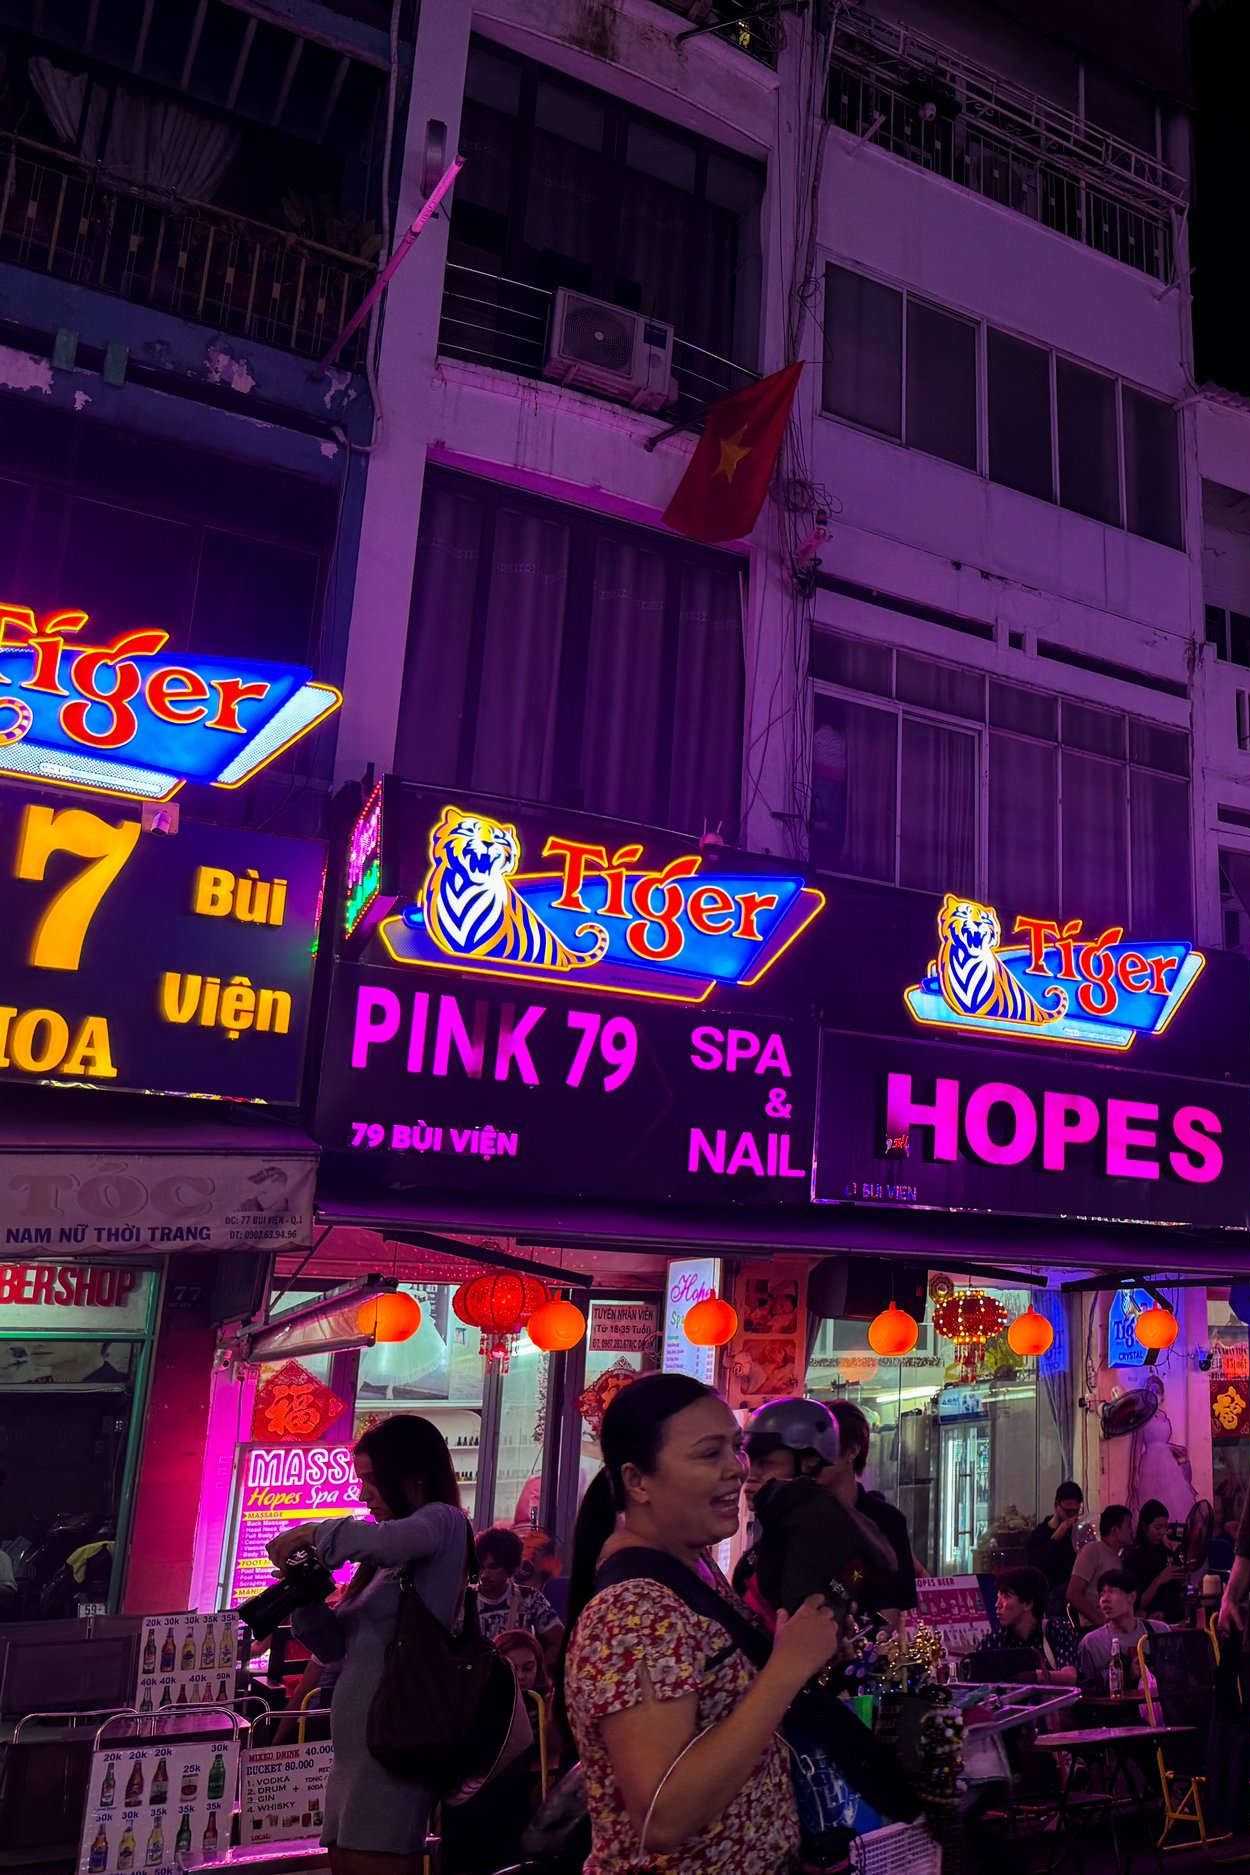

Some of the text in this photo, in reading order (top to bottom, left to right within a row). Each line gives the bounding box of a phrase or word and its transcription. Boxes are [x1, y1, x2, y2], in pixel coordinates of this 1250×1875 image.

[0, 604, 271, 749] Tiger
[15, 804, 142, 971] 7
[193, 864, 288, 926] Bùi
[542, 836, 777, 961] Tiger
[1014, 915, 1177, 1015] Tiger
[162, 971, 293, 1041] Viện
[351, 985, 638, 1093] PINK 79
[690, 1026, 792, 1078] SPA
[764, 1086, 793, 1120] &
[886, 1072, 1224, 1184] HOPES
[351, 1119, 518, 1161] 79 BÙI VIỆN
[687, 1127, 806, 1178] NAIL
[241, 1215, 251, 1225] 77
[6, 1223, 212, 1244] NAM NỮ THỜI TRANG
[174, 1286, 204, 1301] 77
[610, 1325, 630, 1334] 18-35
[1114, 1316, 1137, 1348] Tig
[1118, 1350, 1144, 1361] CRYSTAL
[248, 1448, 362, 1487] MASS
[247, 1485, 361, 1510] Hopes Spa &
[146, 1614, 236, 1627] 20k 30k 30k 35k 35k
[140, 1672, 231, 1686] 40k 40k 40k 50k
[103, 1744, 228, 1762] 20k 20k 20k 30k
[276, 1749, 300, 1759] DRINK
[183, 1764, 200, 1773] 25k
[246, 1763, 282, 1776] BUCKET
[284, 1759, 314, 1771] 80.000
[257, 1776, 290, 1786] VODKA
[258, 1785, 286, 1795] DRUM
[257, 1801, 295, 1812] WHISKY
[258, 1794, 275, 1803] GIN
[121, 1811, 139, 1820] 30k
[150, 1808, 167, 1817] 35k
[178, 1805, 195, 1813] 35k
[206, 1802, 222, 1811] 35k
